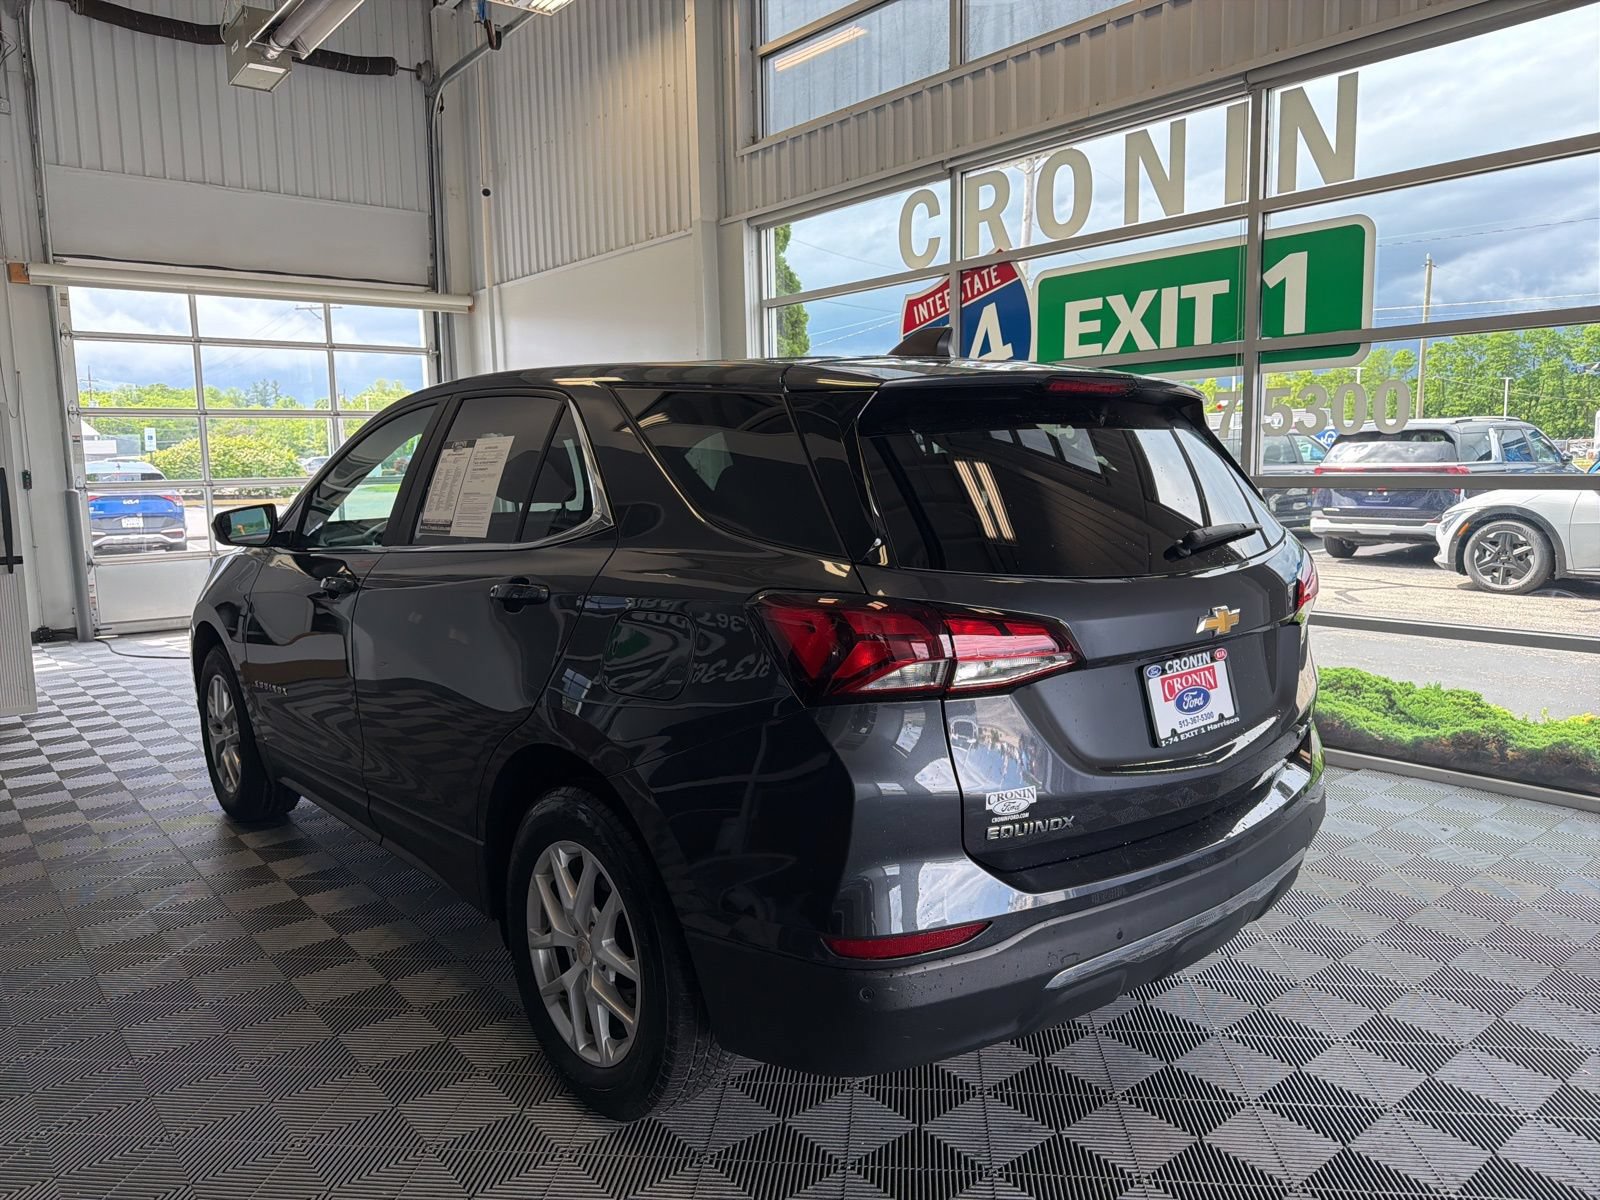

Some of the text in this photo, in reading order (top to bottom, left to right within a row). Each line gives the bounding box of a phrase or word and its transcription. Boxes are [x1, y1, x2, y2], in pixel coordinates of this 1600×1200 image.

[899, 72, 1358, 270] CRONIN
[914, 265, 1001, 325] INTERTATE
[1063, 251, 1309, 359] EXIT 1
[966, 302, 1014, 360] 4
[1165, 651, 1211, 673] CRONIN
[1164, 669, 1215, 699] CRONIN
[1182, 691, 1205, 710] Ford
[1161, 735, 1179, 747] I-74
[1180, 729, 1199, 740] EXIT
[1207, 717, 1240, 732] Harrison
[1178, 711, 1214, 729] 513-367-5300
[988, 787, 1035, 806] CRONIN
[1001, 801, 1022, 813] Ford
[986, 815, 1075, 841] EQUINOX
